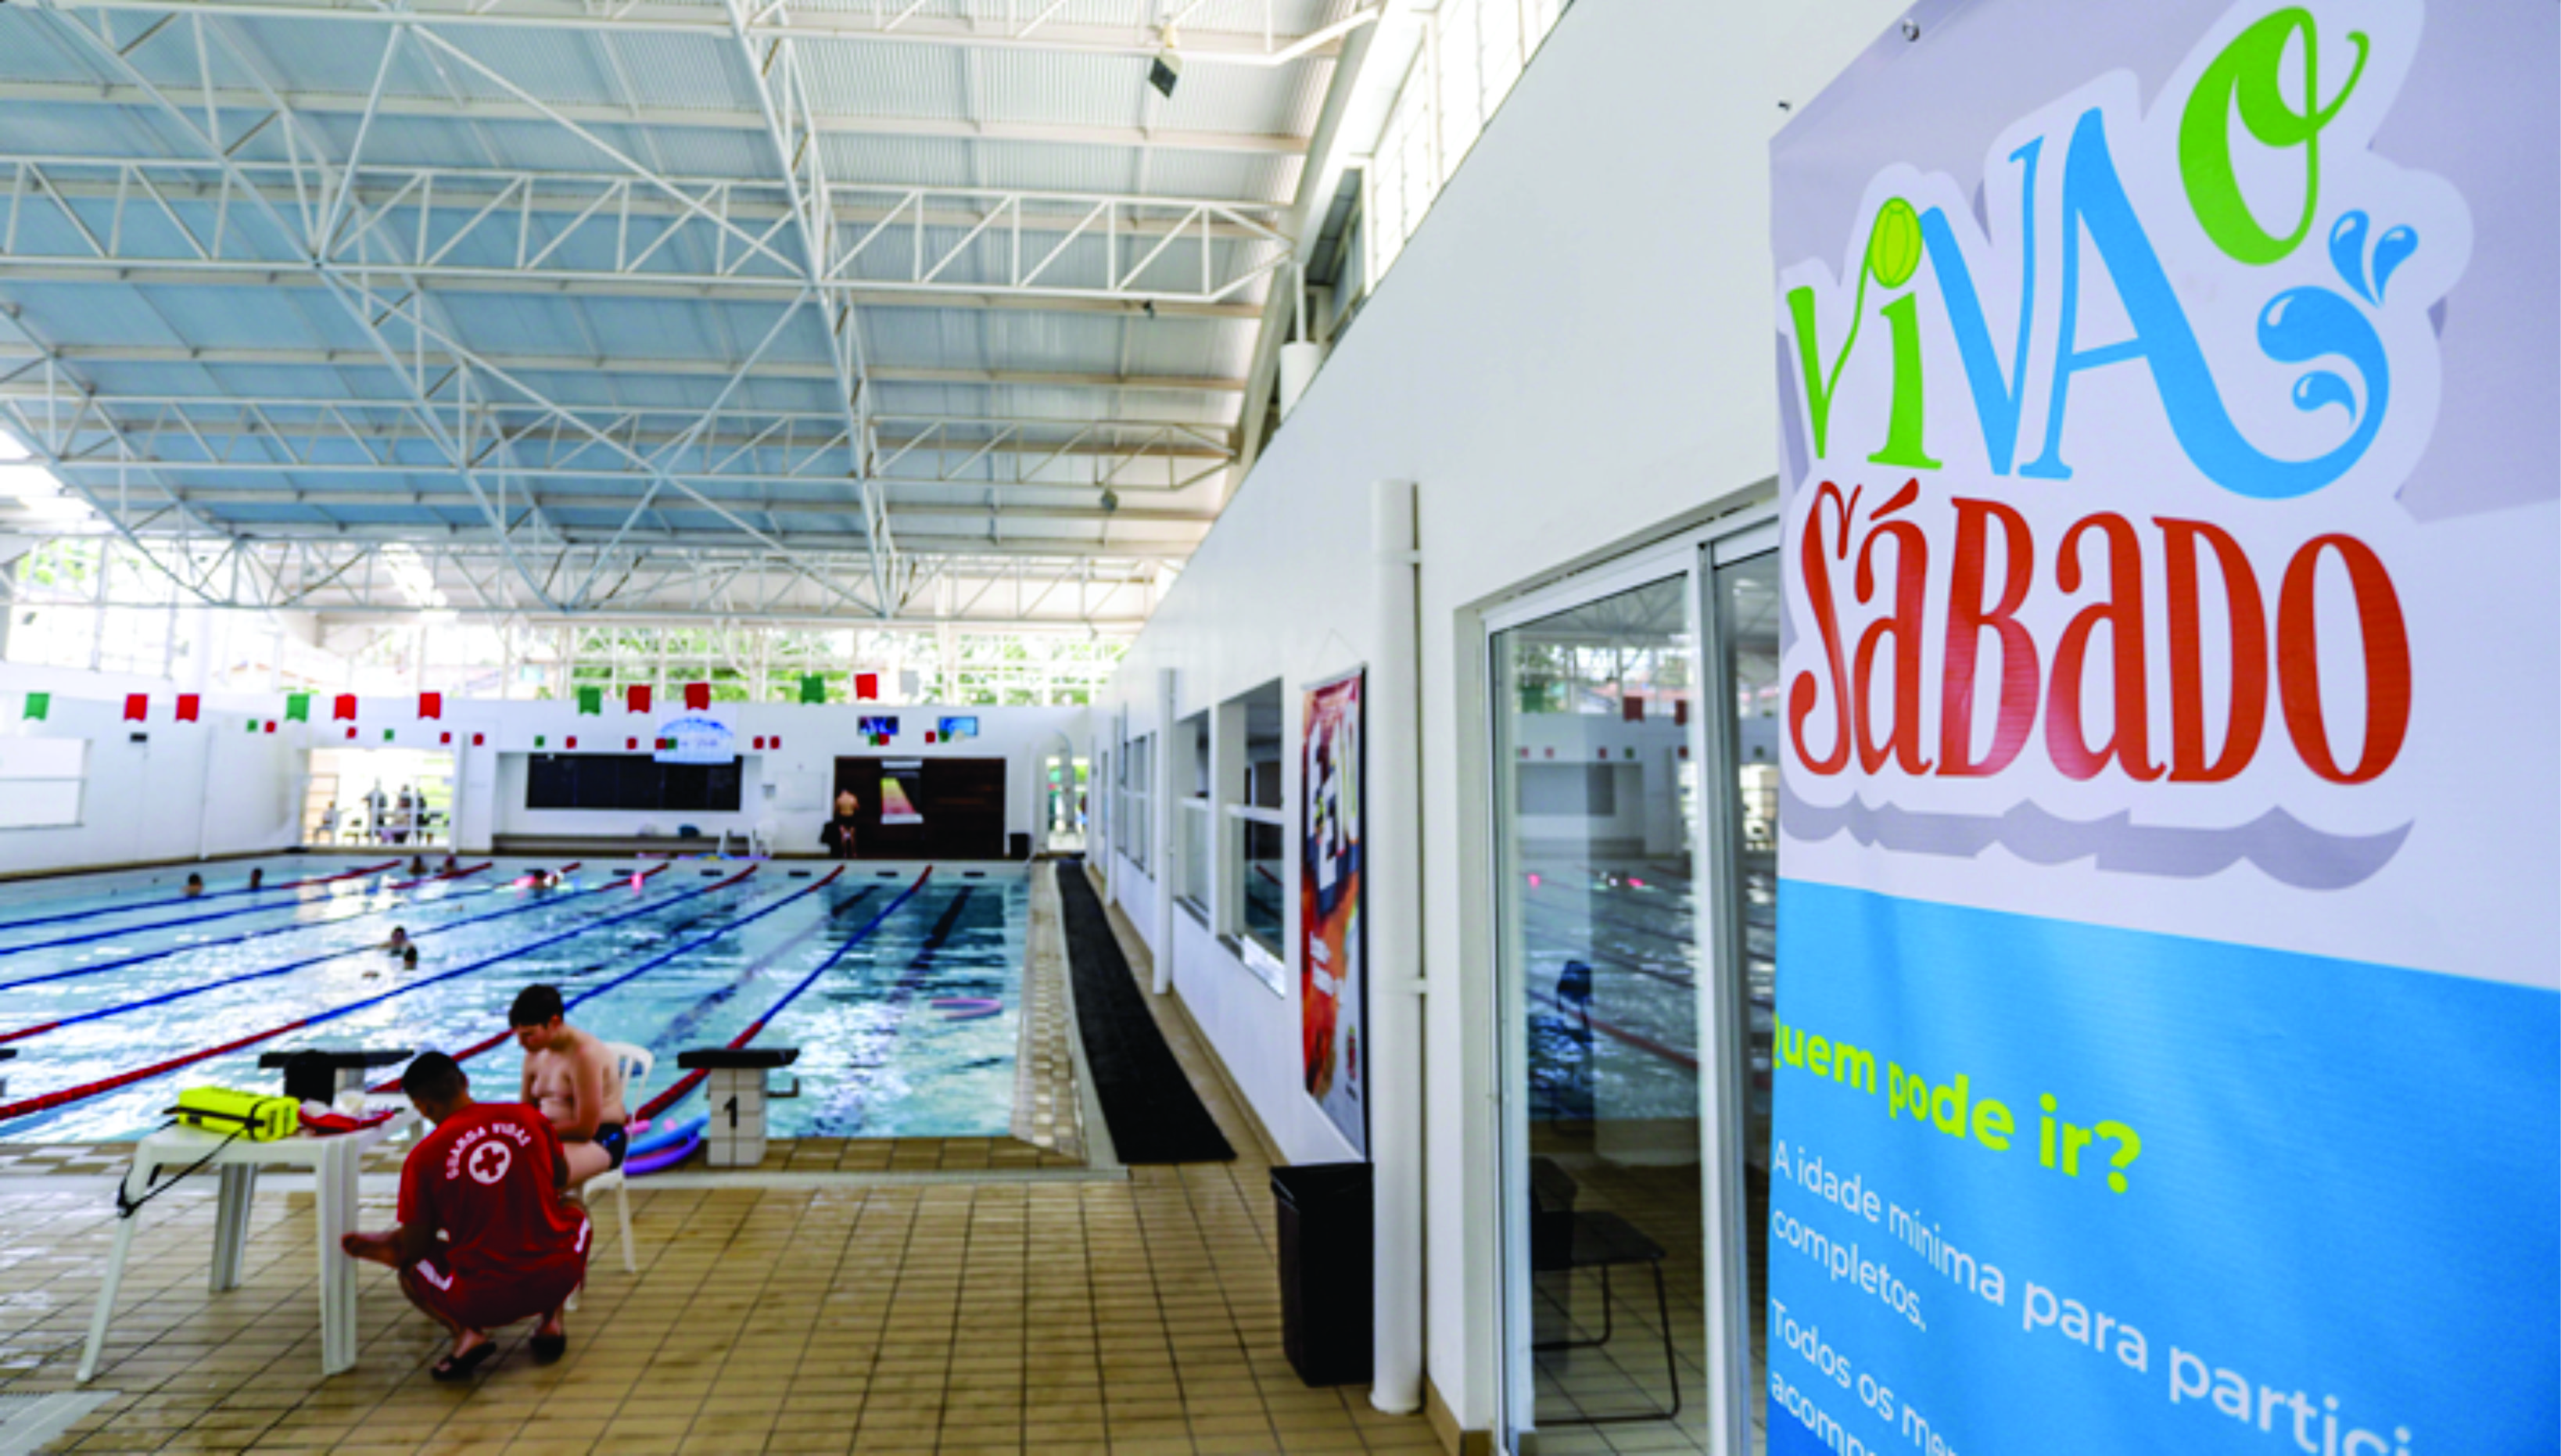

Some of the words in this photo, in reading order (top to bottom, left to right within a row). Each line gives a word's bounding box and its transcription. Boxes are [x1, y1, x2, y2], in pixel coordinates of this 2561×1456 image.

[723, 1096, 737, 1128] 1
[1888, 1060, 2014, 1151] pode
[2039, 1092, 2142, 1195] ir?
[1774, 1139, 1792, 1178] A
[1799, 1146, 1881, 1223] idade
[2023, 1281, 2148, 1375] para
[1772, 1298, 1851, 1389] Todos
[1858, 1373, 1893, 1421] os
[1772, 1372, 1877, 1456] acomp
